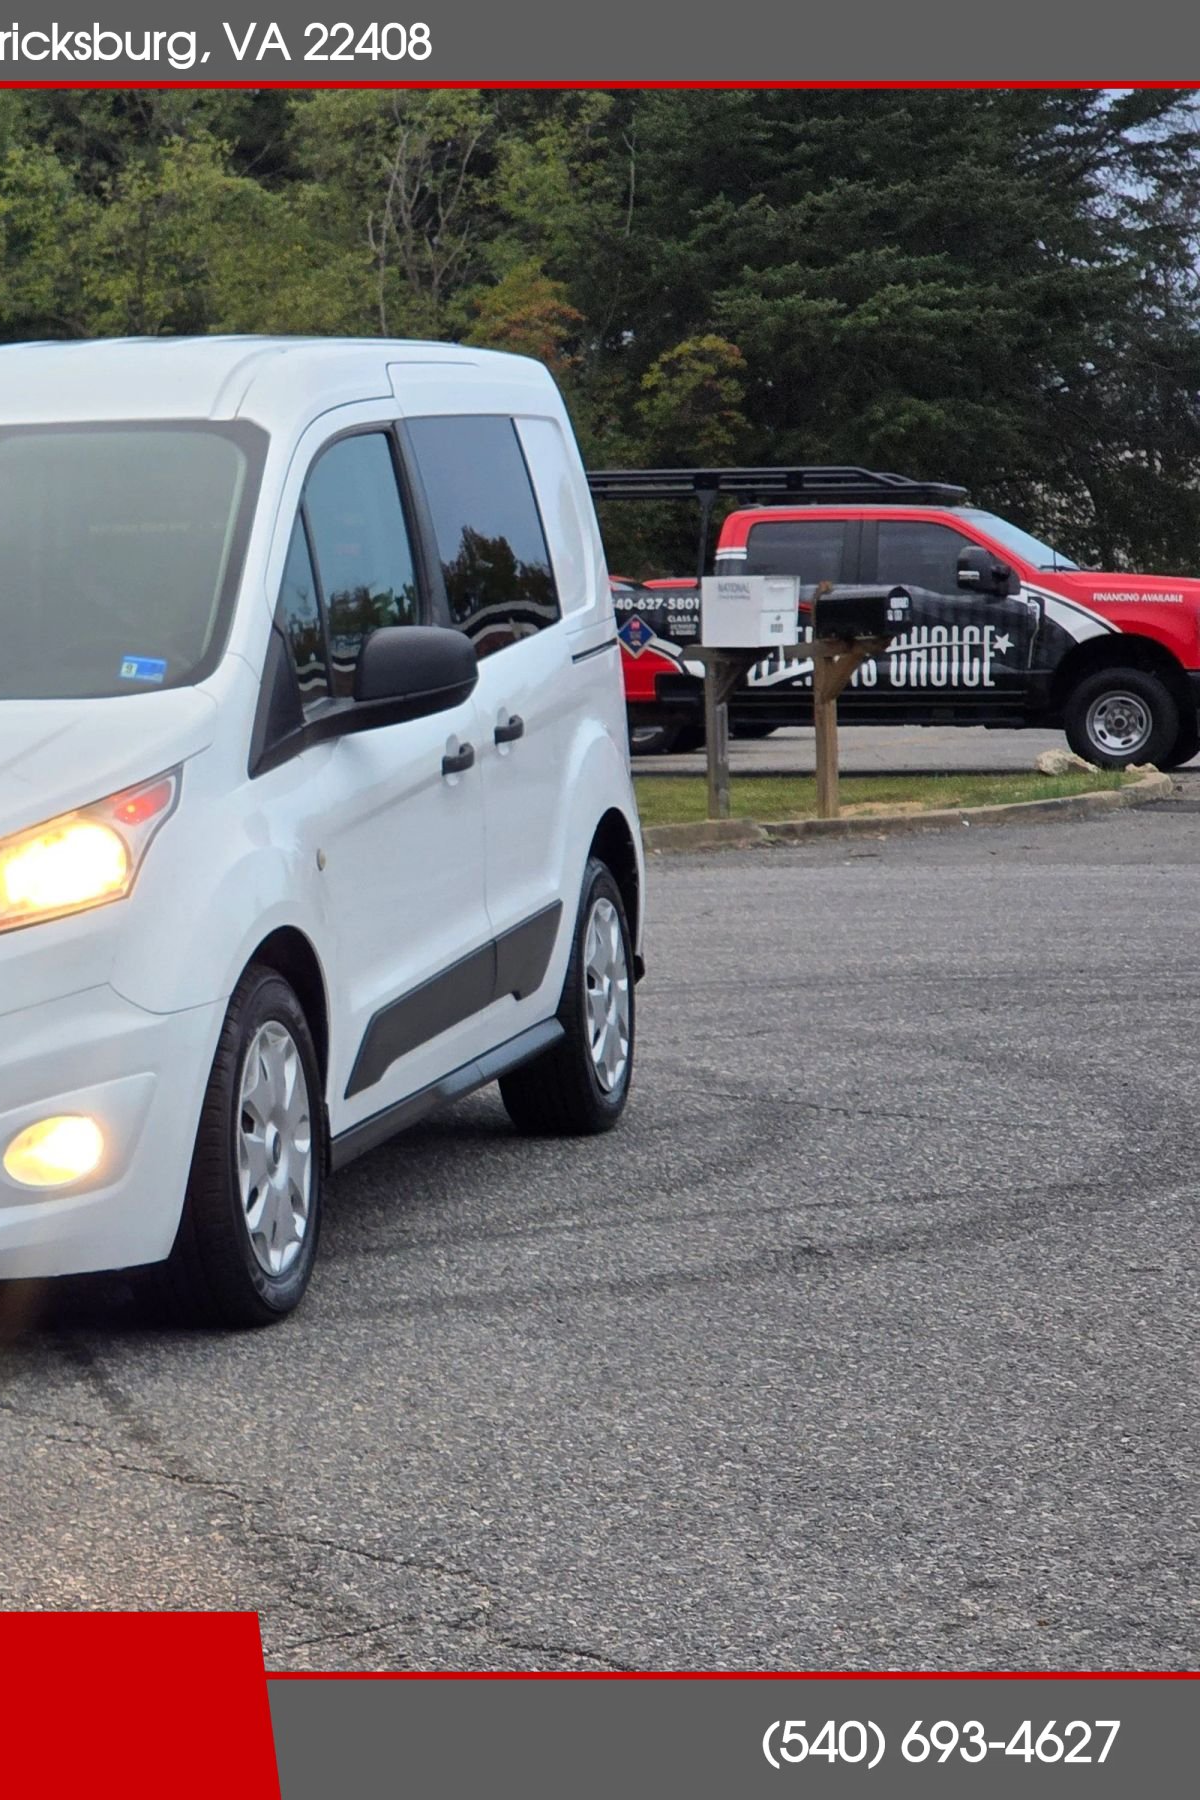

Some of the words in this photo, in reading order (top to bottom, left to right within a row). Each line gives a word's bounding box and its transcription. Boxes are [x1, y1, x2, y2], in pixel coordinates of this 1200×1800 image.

[1140, 593, 1184, 603] AVAILABLE
[612, 598, 700, 610] 40-627-5801
[667, 615, 692, 623] CLASS
[886, 625, 996, 687] CHOICE
